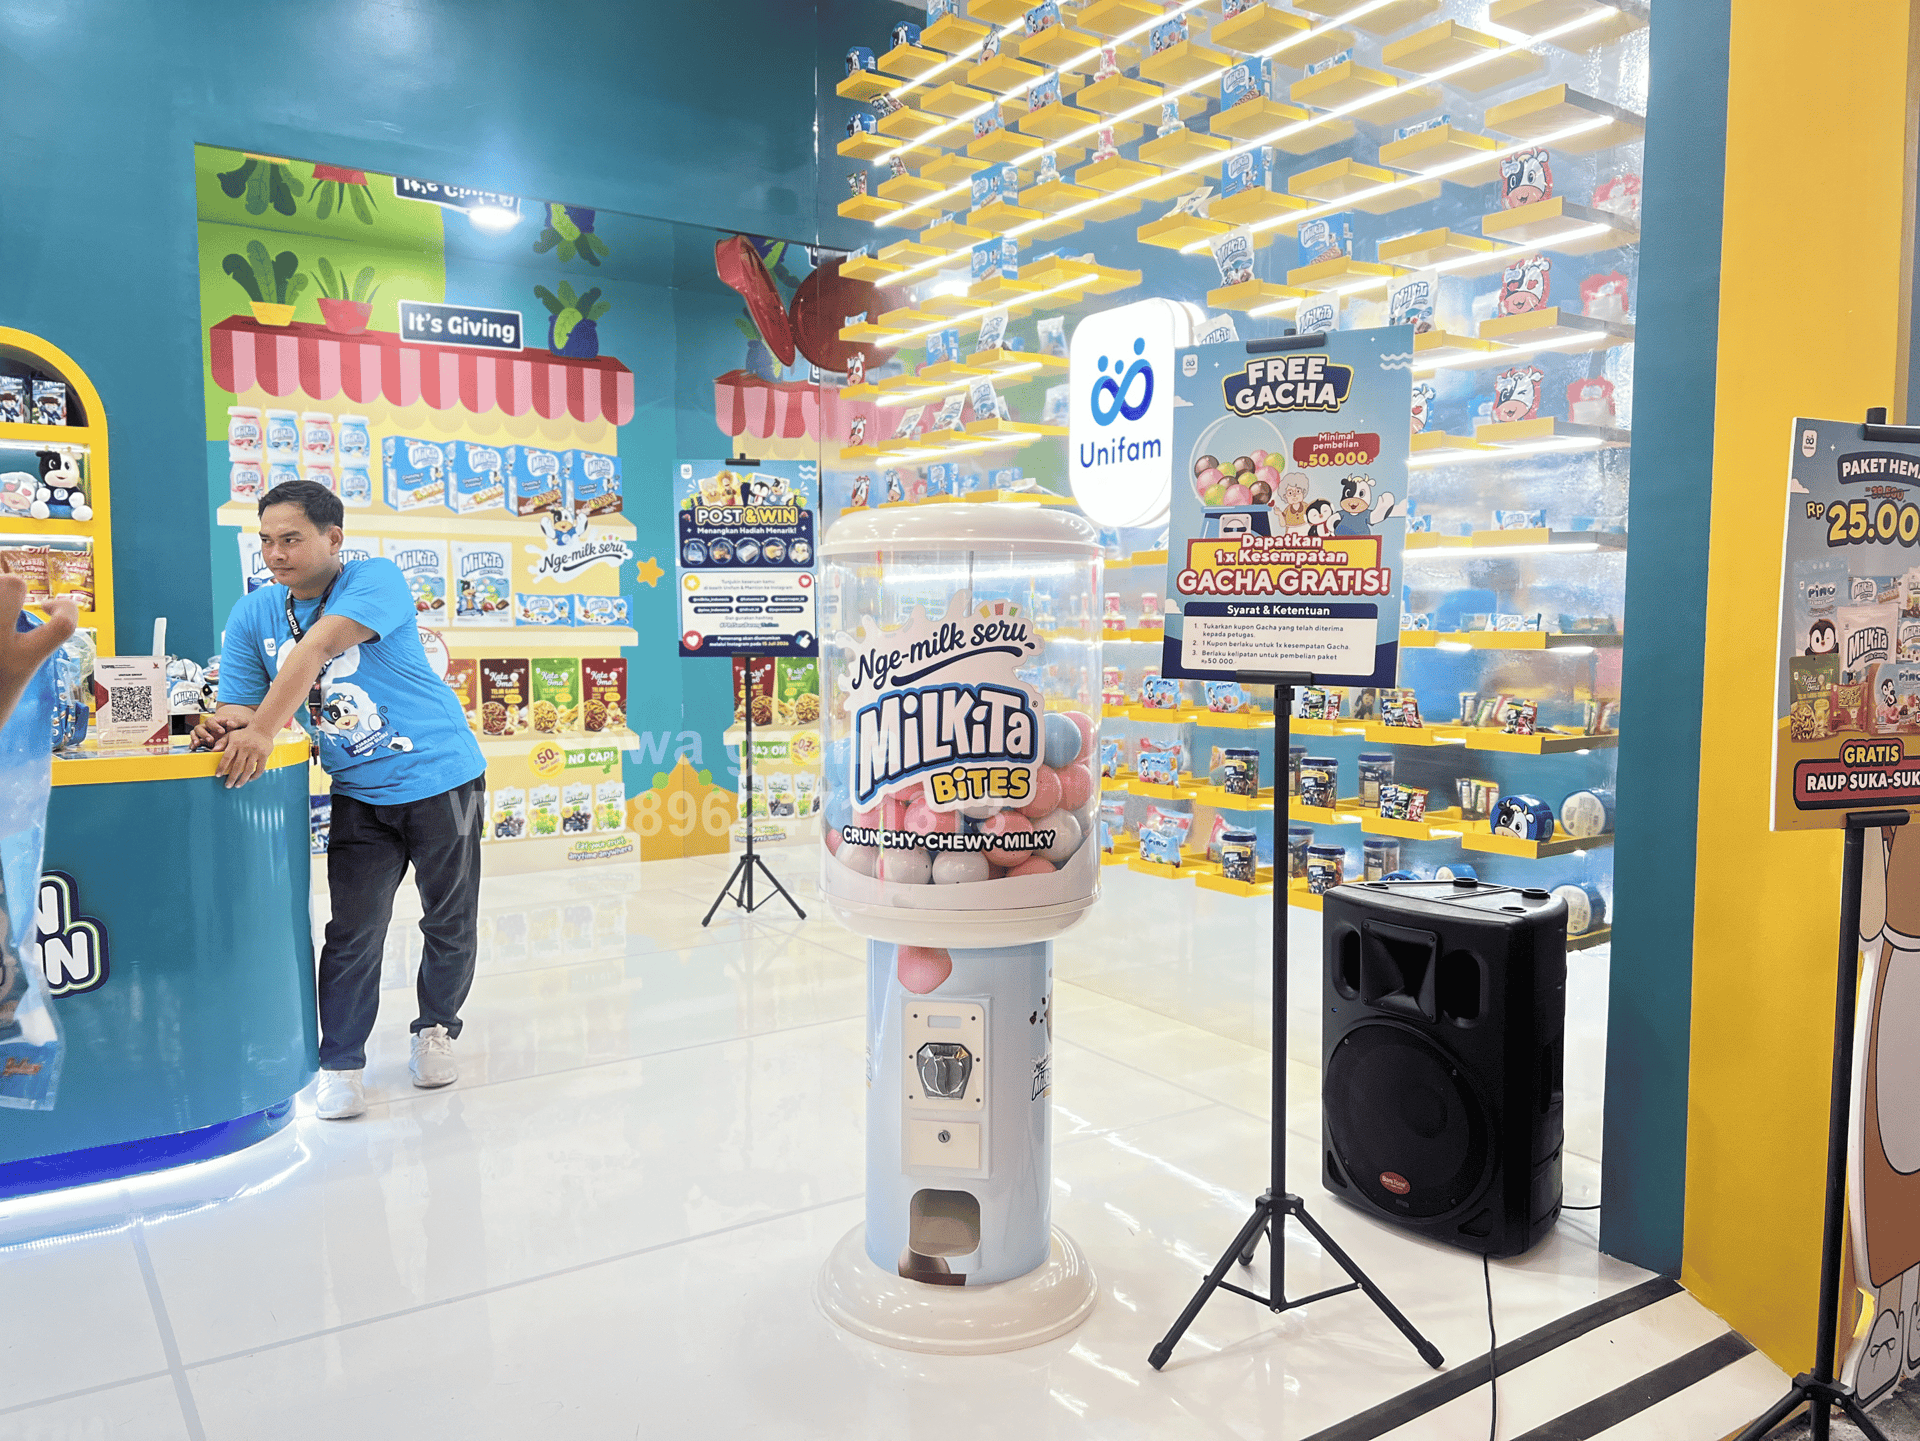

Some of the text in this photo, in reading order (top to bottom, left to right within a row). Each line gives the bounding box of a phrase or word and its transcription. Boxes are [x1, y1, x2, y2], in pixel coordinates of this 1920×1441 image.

[409, 312, 515, 344] It's Giving
[1248, 357, 1326, 385] FREE
[1235, 382, 1336, 410] GACHA
[1319, 431, 1354, 441] Minimal
[1081, 436, 1161, 468] Unifam
[1313, 441, 1359, 451] pembelian
[1842, 458, 1887, 477] PAKET
[698, 509, 796, 522] POST & WIN
[1807, 502, 1824, 517] Rp
[697, 527, 738, 535] Menangkan
[1242, 535, 1322, 549] Dapatkan
[462, 551, 503, 577] MiLKiTa
[539, 542, 624, 573] Nge-milk seru
[1216, 550, 1348, 566] 1x Kesempatan
[1178, 569, 1389, 592] GACHA GRATIS!
[1227, 605, 1330, 616] Syarat & Ketentuan
[852, 619, 1027, 690] Nge-milk seru
[1280, 652, 1316, 660] pembelian
[1847, 626, 1888, 668] MiLKiTa
[858, 688, 1035, 799] MiLKiTa
[569, 752, 614, 764] NO CAP!
[1844, 745, 1899, 763] GRATIS
[1807, 775, 1847, 791] RAUP
[843, 826, 1054, 850] CRUNCHY CHEWY MILKY
[598, 845, 633, 858] anywhere
